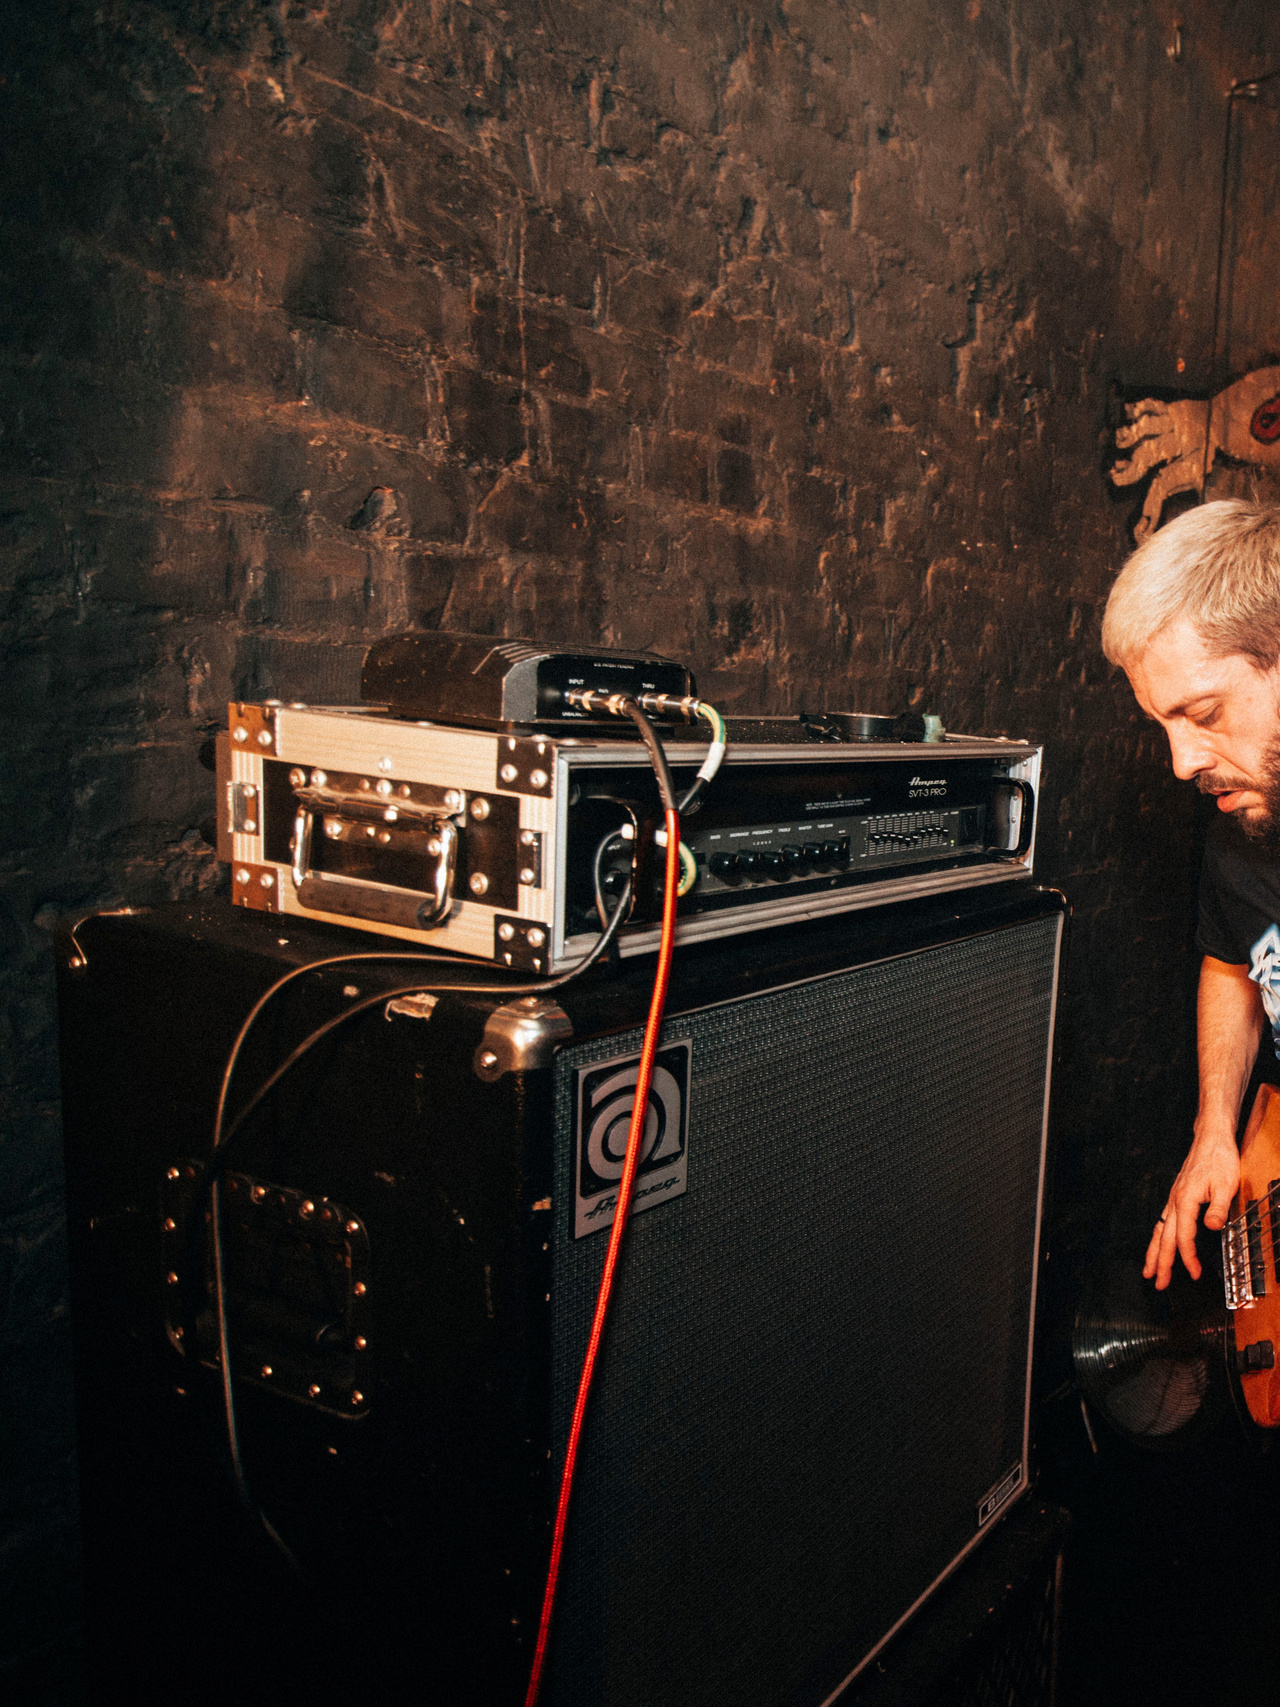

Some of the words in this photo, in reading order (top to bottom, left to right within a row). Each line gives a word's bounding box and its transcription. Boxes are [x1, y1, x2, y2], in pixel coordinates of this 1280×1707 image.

[909, 777, 947, 786] Ampeg
[909, 788, 929, 798] SVT-3
[930, 788, 947, 796] PRO
